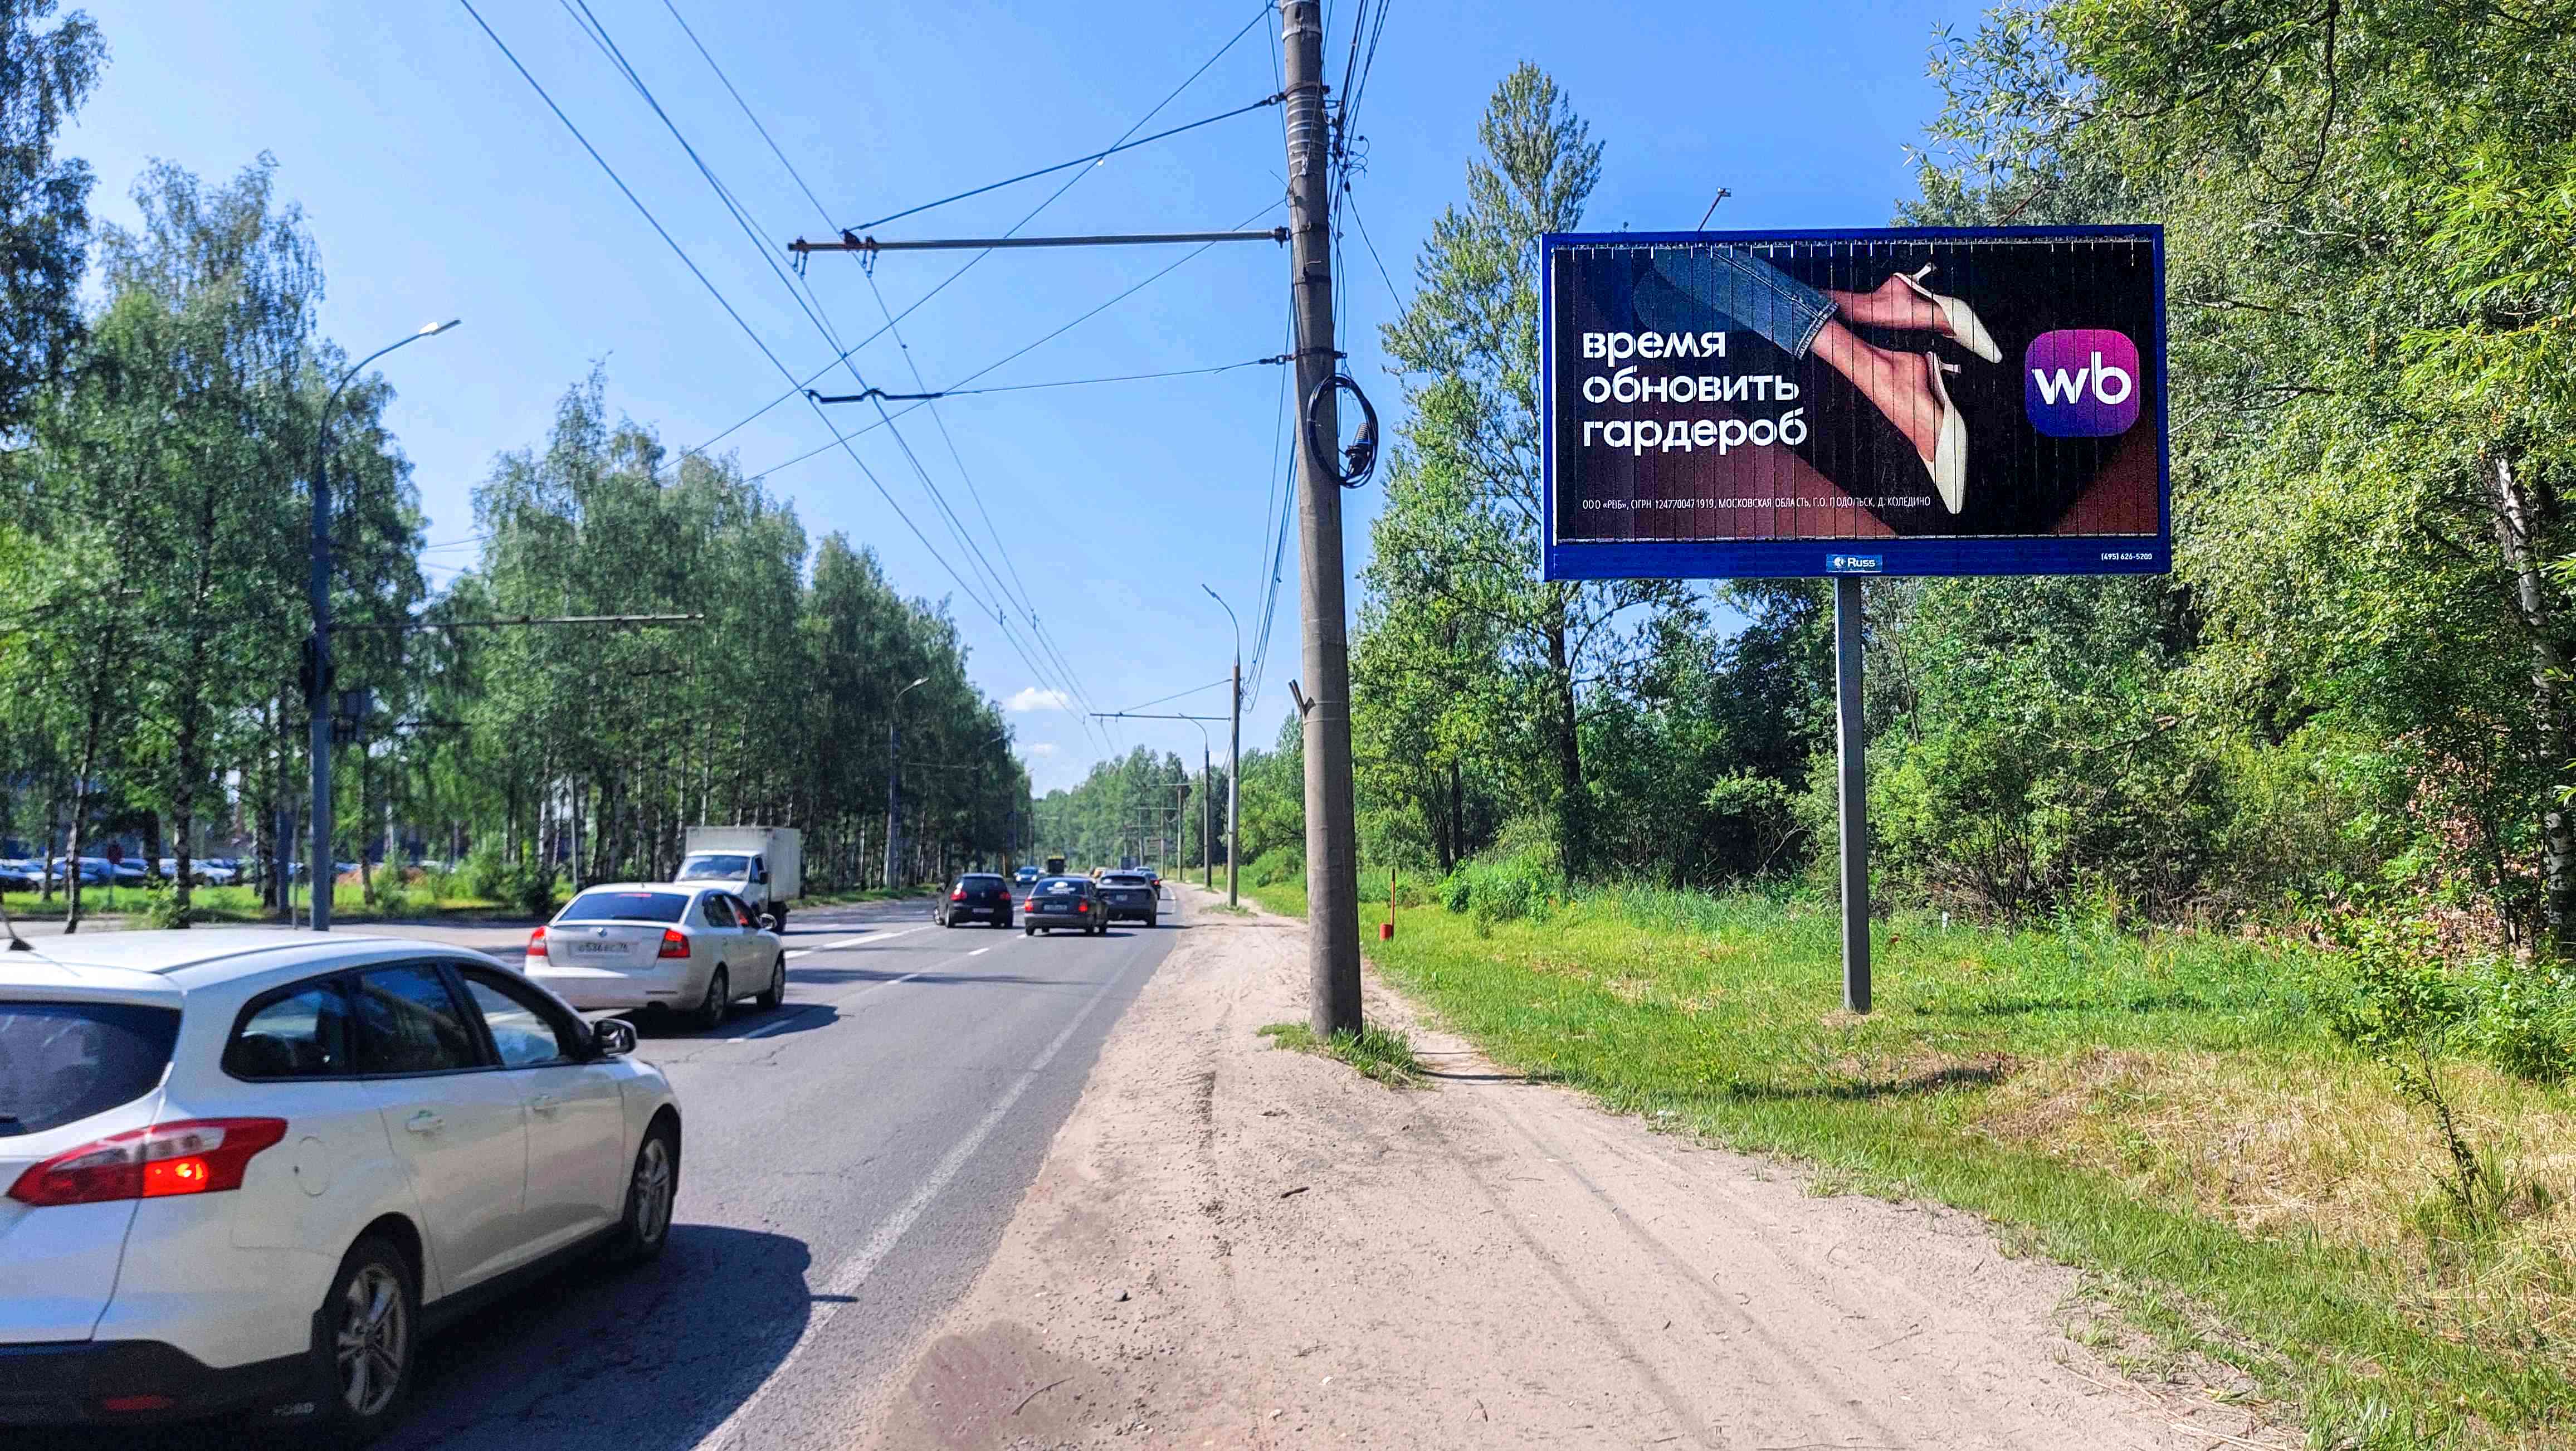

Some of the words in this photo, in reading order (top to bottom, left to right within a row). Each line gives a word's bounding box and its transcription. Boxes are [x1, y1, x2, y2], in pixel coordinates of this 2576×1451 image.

[1583, 331, 1725, 367] время
[1583, 366, 1799, 403] обновить
[2032, 351, 2132, 405] wb
[1583, 407, 1807, 456] гардероб
[1582, 499, 1601, 509] ООО
[1631, 499, 1652, 509] ОГРН
[1719, 498, 1772, 509] МОСКОВСКАЯ
[1775, 497, 1811, 508] ОБЛАСТЬ,
[1813, 497, 1827, 508] Г.О.
[1877, 496, 1886, 508] Д.
[1887, 496, 1930, 508] КОЛЕДИНО
[1847, 557, 1876, 567] Russ
[2101, 552, 2119, 561] (495)
